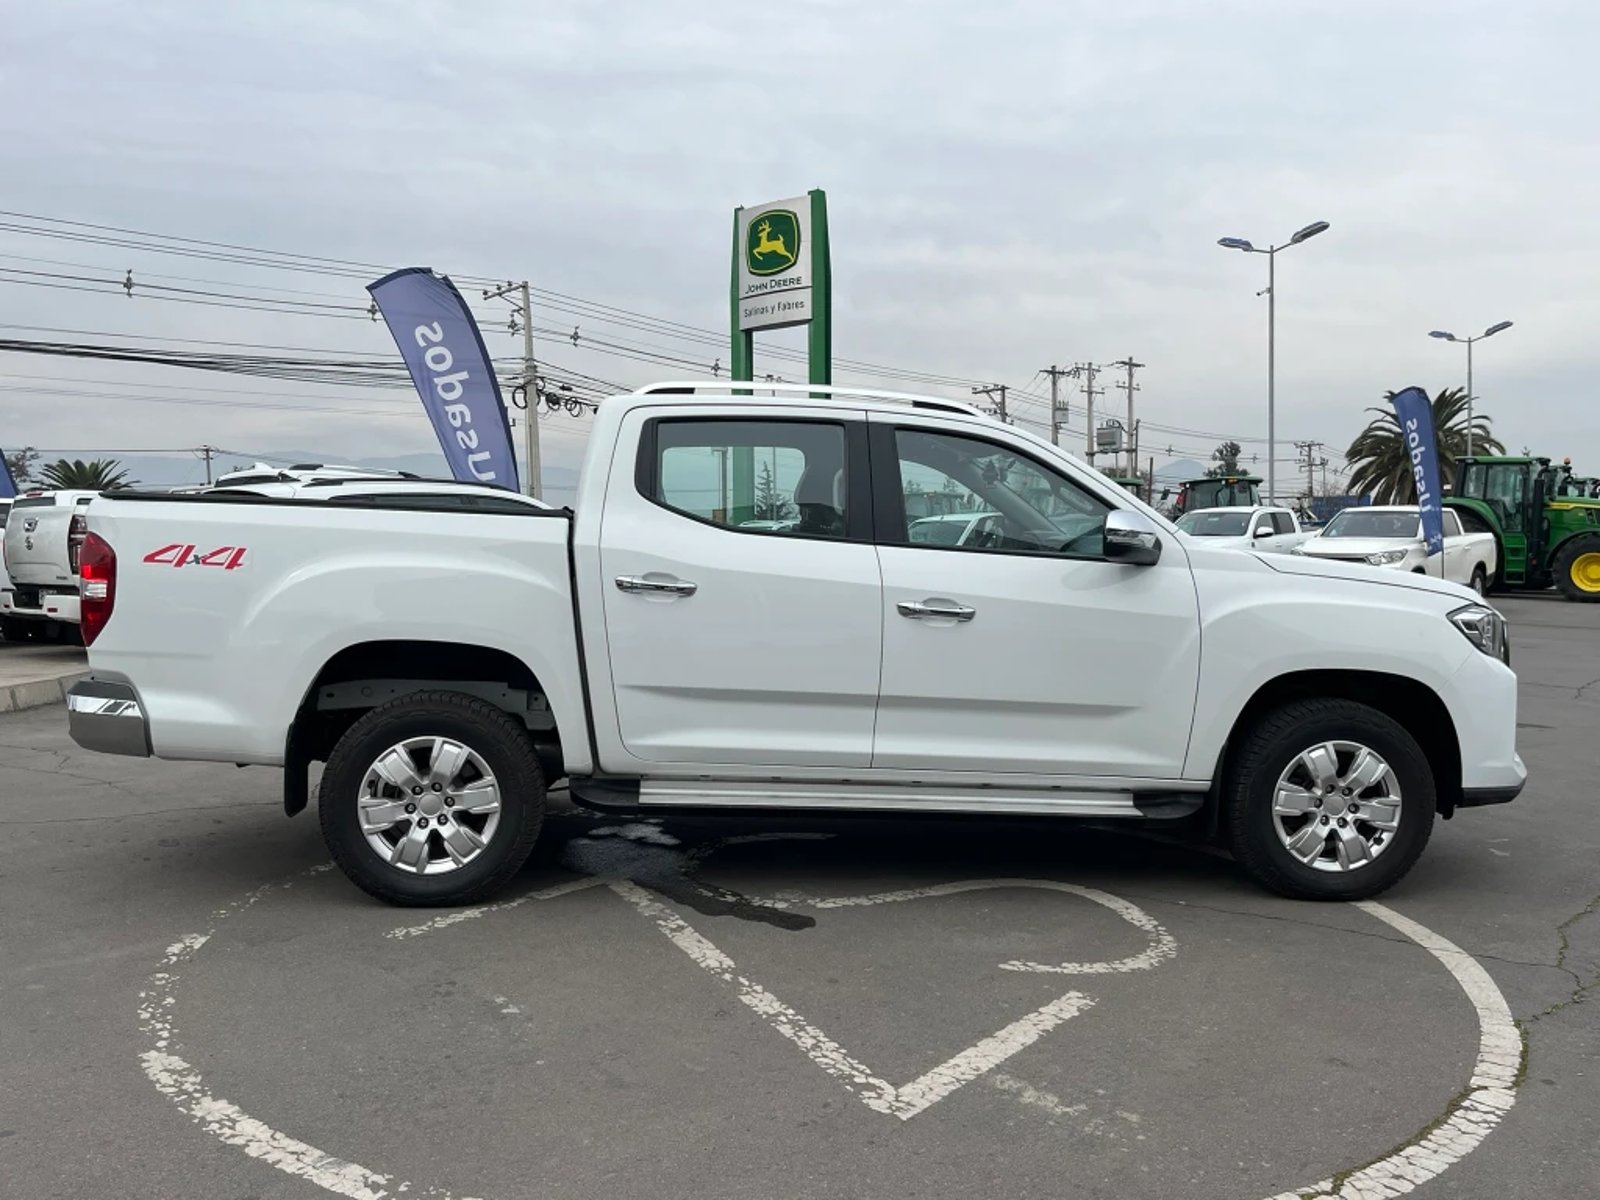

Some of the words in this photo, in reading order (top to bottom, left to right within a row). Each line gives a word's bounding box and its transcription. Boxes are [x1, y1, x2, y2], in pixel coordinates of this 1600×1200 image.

[745, 282, 768, 294] JOHN
[769, 276, 803, 289] DEERE
[143, 544, 247, 570] 4x4
